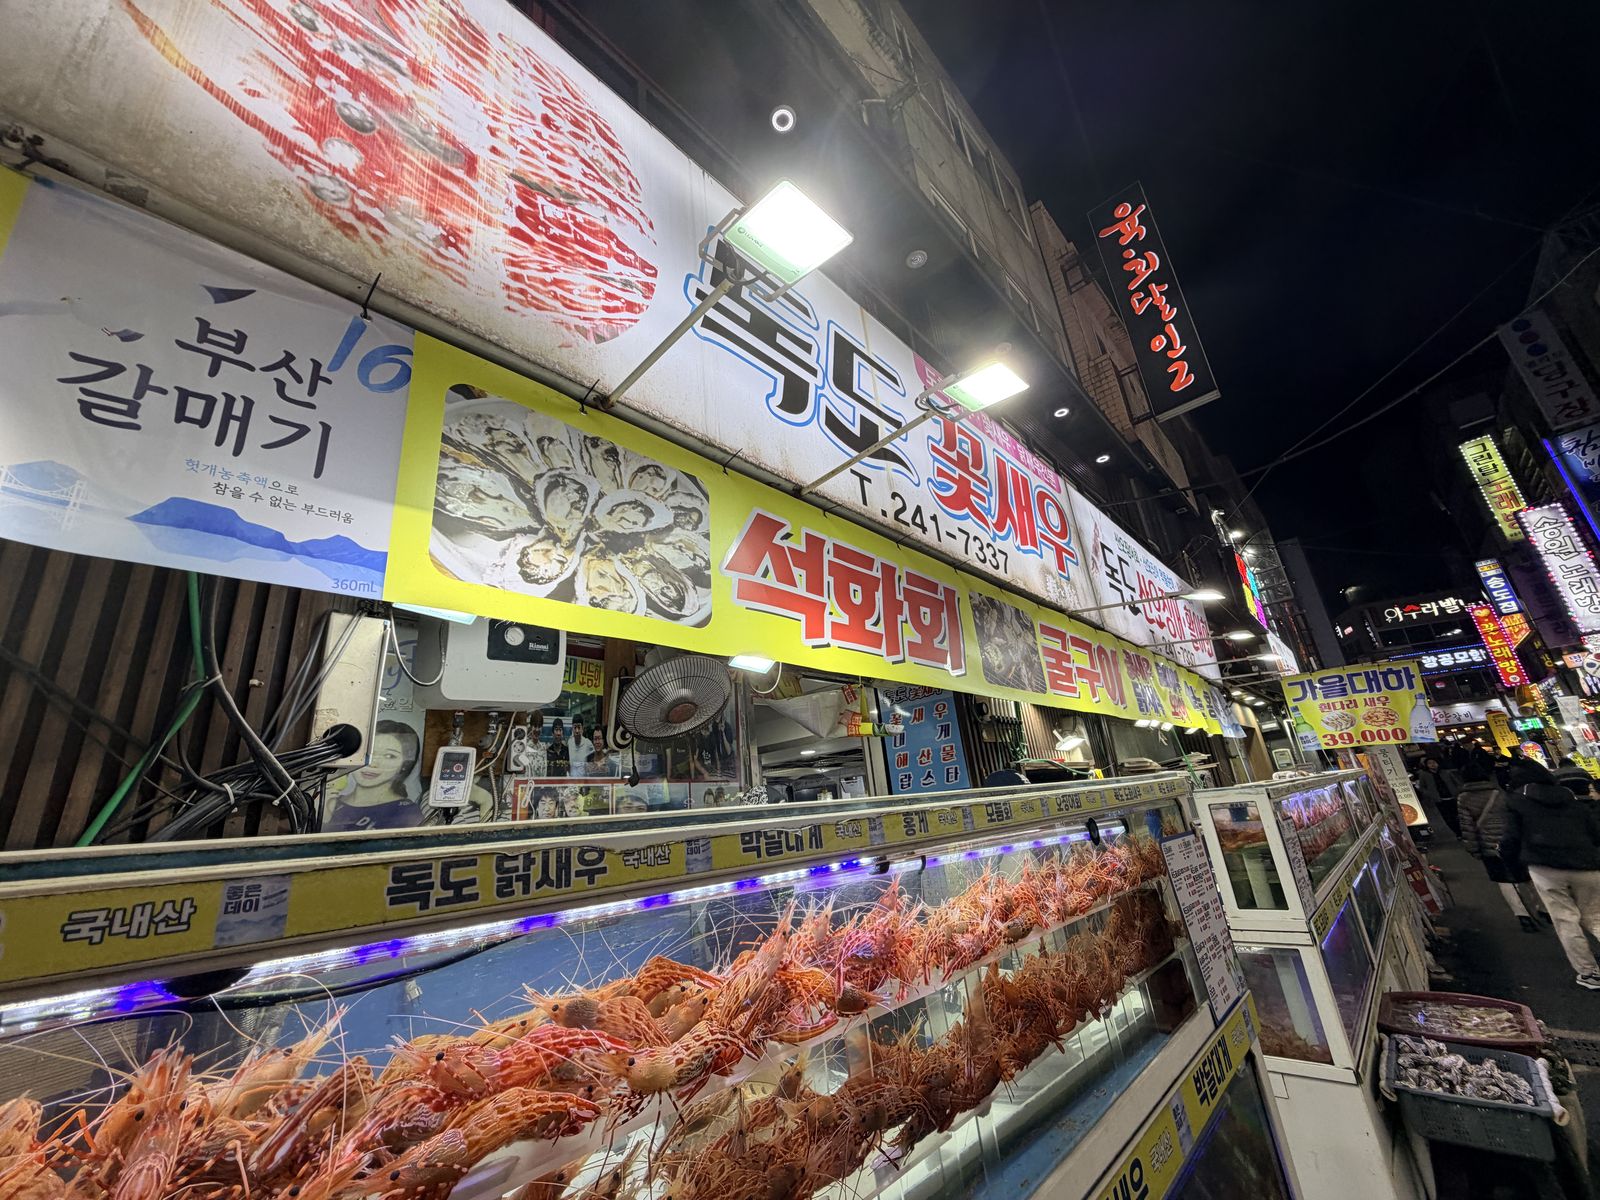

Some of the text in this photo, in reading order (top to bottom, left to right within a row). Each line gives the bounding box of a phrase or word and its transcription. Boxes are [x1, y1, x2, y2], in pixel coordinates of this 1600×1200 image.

[175, 316, 333, 410] 부산
[56, 350, 333, 480] 갈매기
[688, 228, 1079, 580] 독도 꽃새우
[212, 481, 355, 525] 참을 수 없는 부드러움
[331, 576, 378, 594] 360mL
[1100, 541, 1143, 617] 독도
[720, 507, 967, 677] 석화회
[1038, 620, 1128, 709] 굴구이
[528, 642, 550, 651] Rinnai
[1421, 649, 1487, 669] 항공모함
[1287, 666, 1417, 703] 가을대하
[1318, 695, 1391, 713] 흰다리 새우
[1322, 727, 1408, 747] 39,000
[896, 744, 956, 769] 해산물
[899, 766, 960, 791] 랍스타
[835, 820, 863, 839] 국내산
[385, 845, 672, 912] 독도 닭새우 국내산
[225, 881, 263, 902] 좋은
[223, 898, 261, 916] 데이
[60, 898, 198, 946] 국내산
